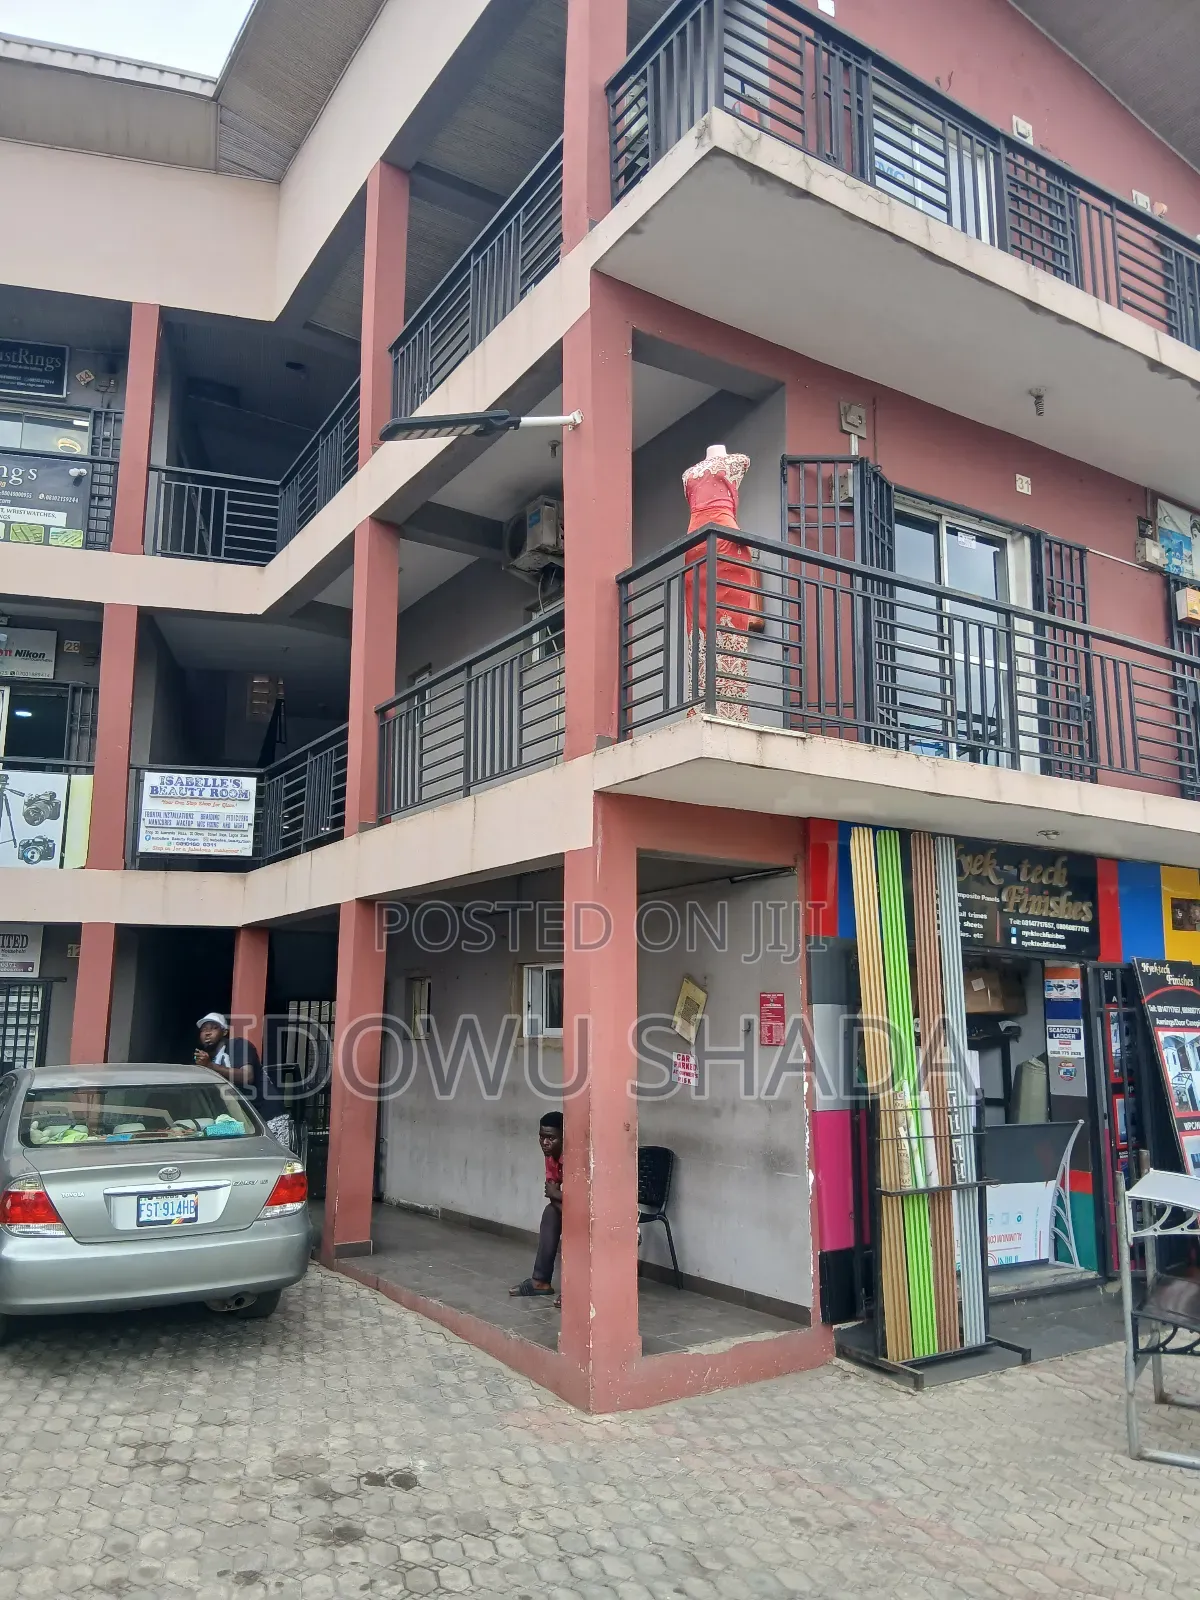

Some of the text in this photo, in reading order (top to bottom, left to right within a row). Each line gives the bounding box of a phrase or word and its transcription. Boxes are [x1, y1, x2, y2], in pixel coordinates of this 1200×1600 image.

[1017, 476, 1030, 493] 31
[65, 642, 80, 652] 28
[14, 649, 46, 659] Nikon
[159, 776, 242, 789] ISABELLE'S
[150, 785, 250, 799] BEAUTY ROOM
[163, 811, 195, 820] INSTALLATIONS
[958, 892, 981, 900] mposite
[1001, 885, 1093, 922] Finishes
[963, 920, 984, 929] sheets
[1166, 974, 1194, 987] Finishes
[676, 1053, 690, 1062] CAR
[673, 1061, 697, 1071] PARKED
[677, 1076, 692, 1084] RISK
[61, 1191, 85, 1199] TOYOTA
[139, 1199, 196, 1218] FST-914HB
